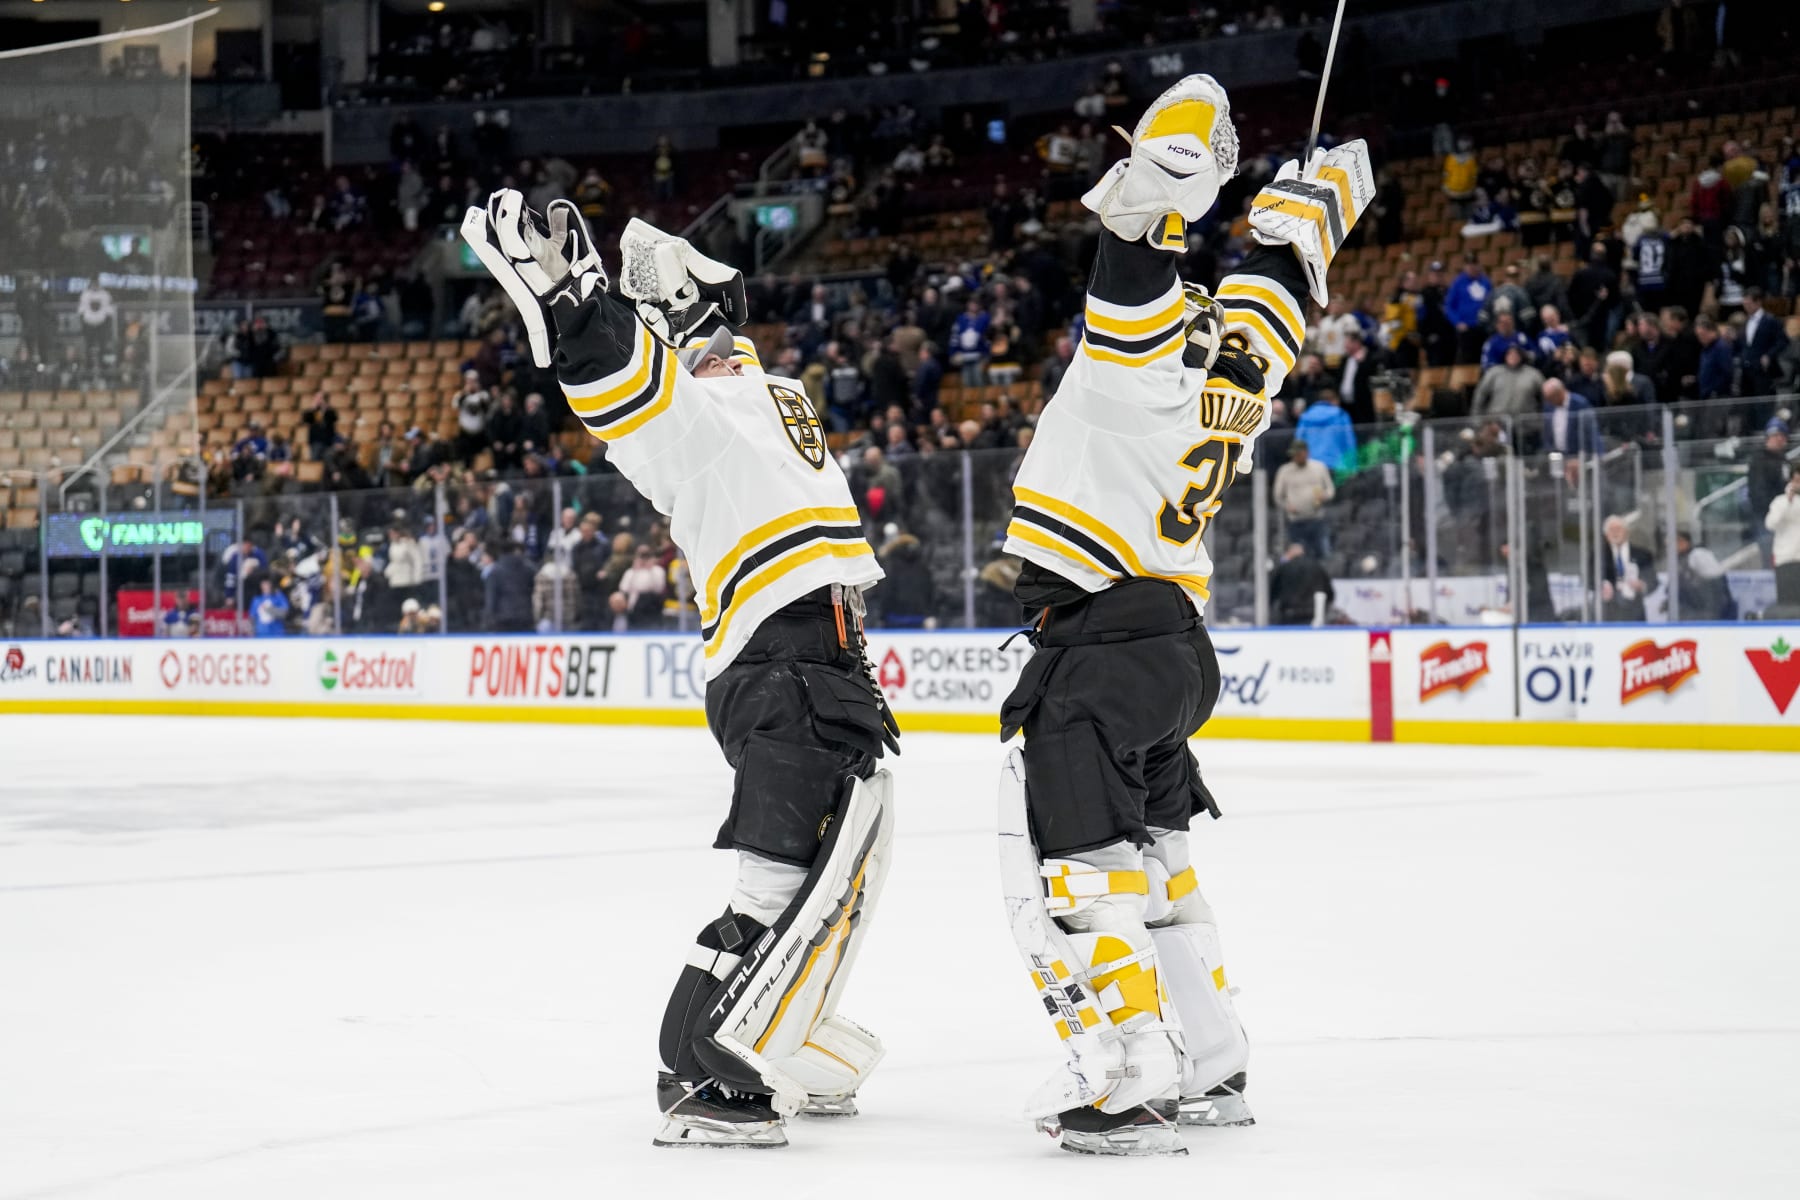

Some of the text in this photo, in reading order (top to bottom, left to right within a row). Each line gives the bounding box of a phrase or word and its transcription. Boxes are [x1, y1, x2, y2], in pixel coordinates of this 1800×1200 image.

[1167, 144, 1201, 159] MACH
[1253, 199, 1286, 216] MACH
[1199, 391, 1265, 437] ULLMAR
[46, 656, 134, 683] CANADIAN
[188, 653, 272, 686] ROGERS
[342, 649, 416, 689] Castrol
[468, 644, 616, 699] POINTSBET
[1278, 667, 1335, 684] PROUD
[912, 678, 993, 701] CASINO
[709, 928, 776, 1020] TRUE
[734, 935, 803, 1033] TRUE
[1030, 953, 1085, 1035] BAUER
